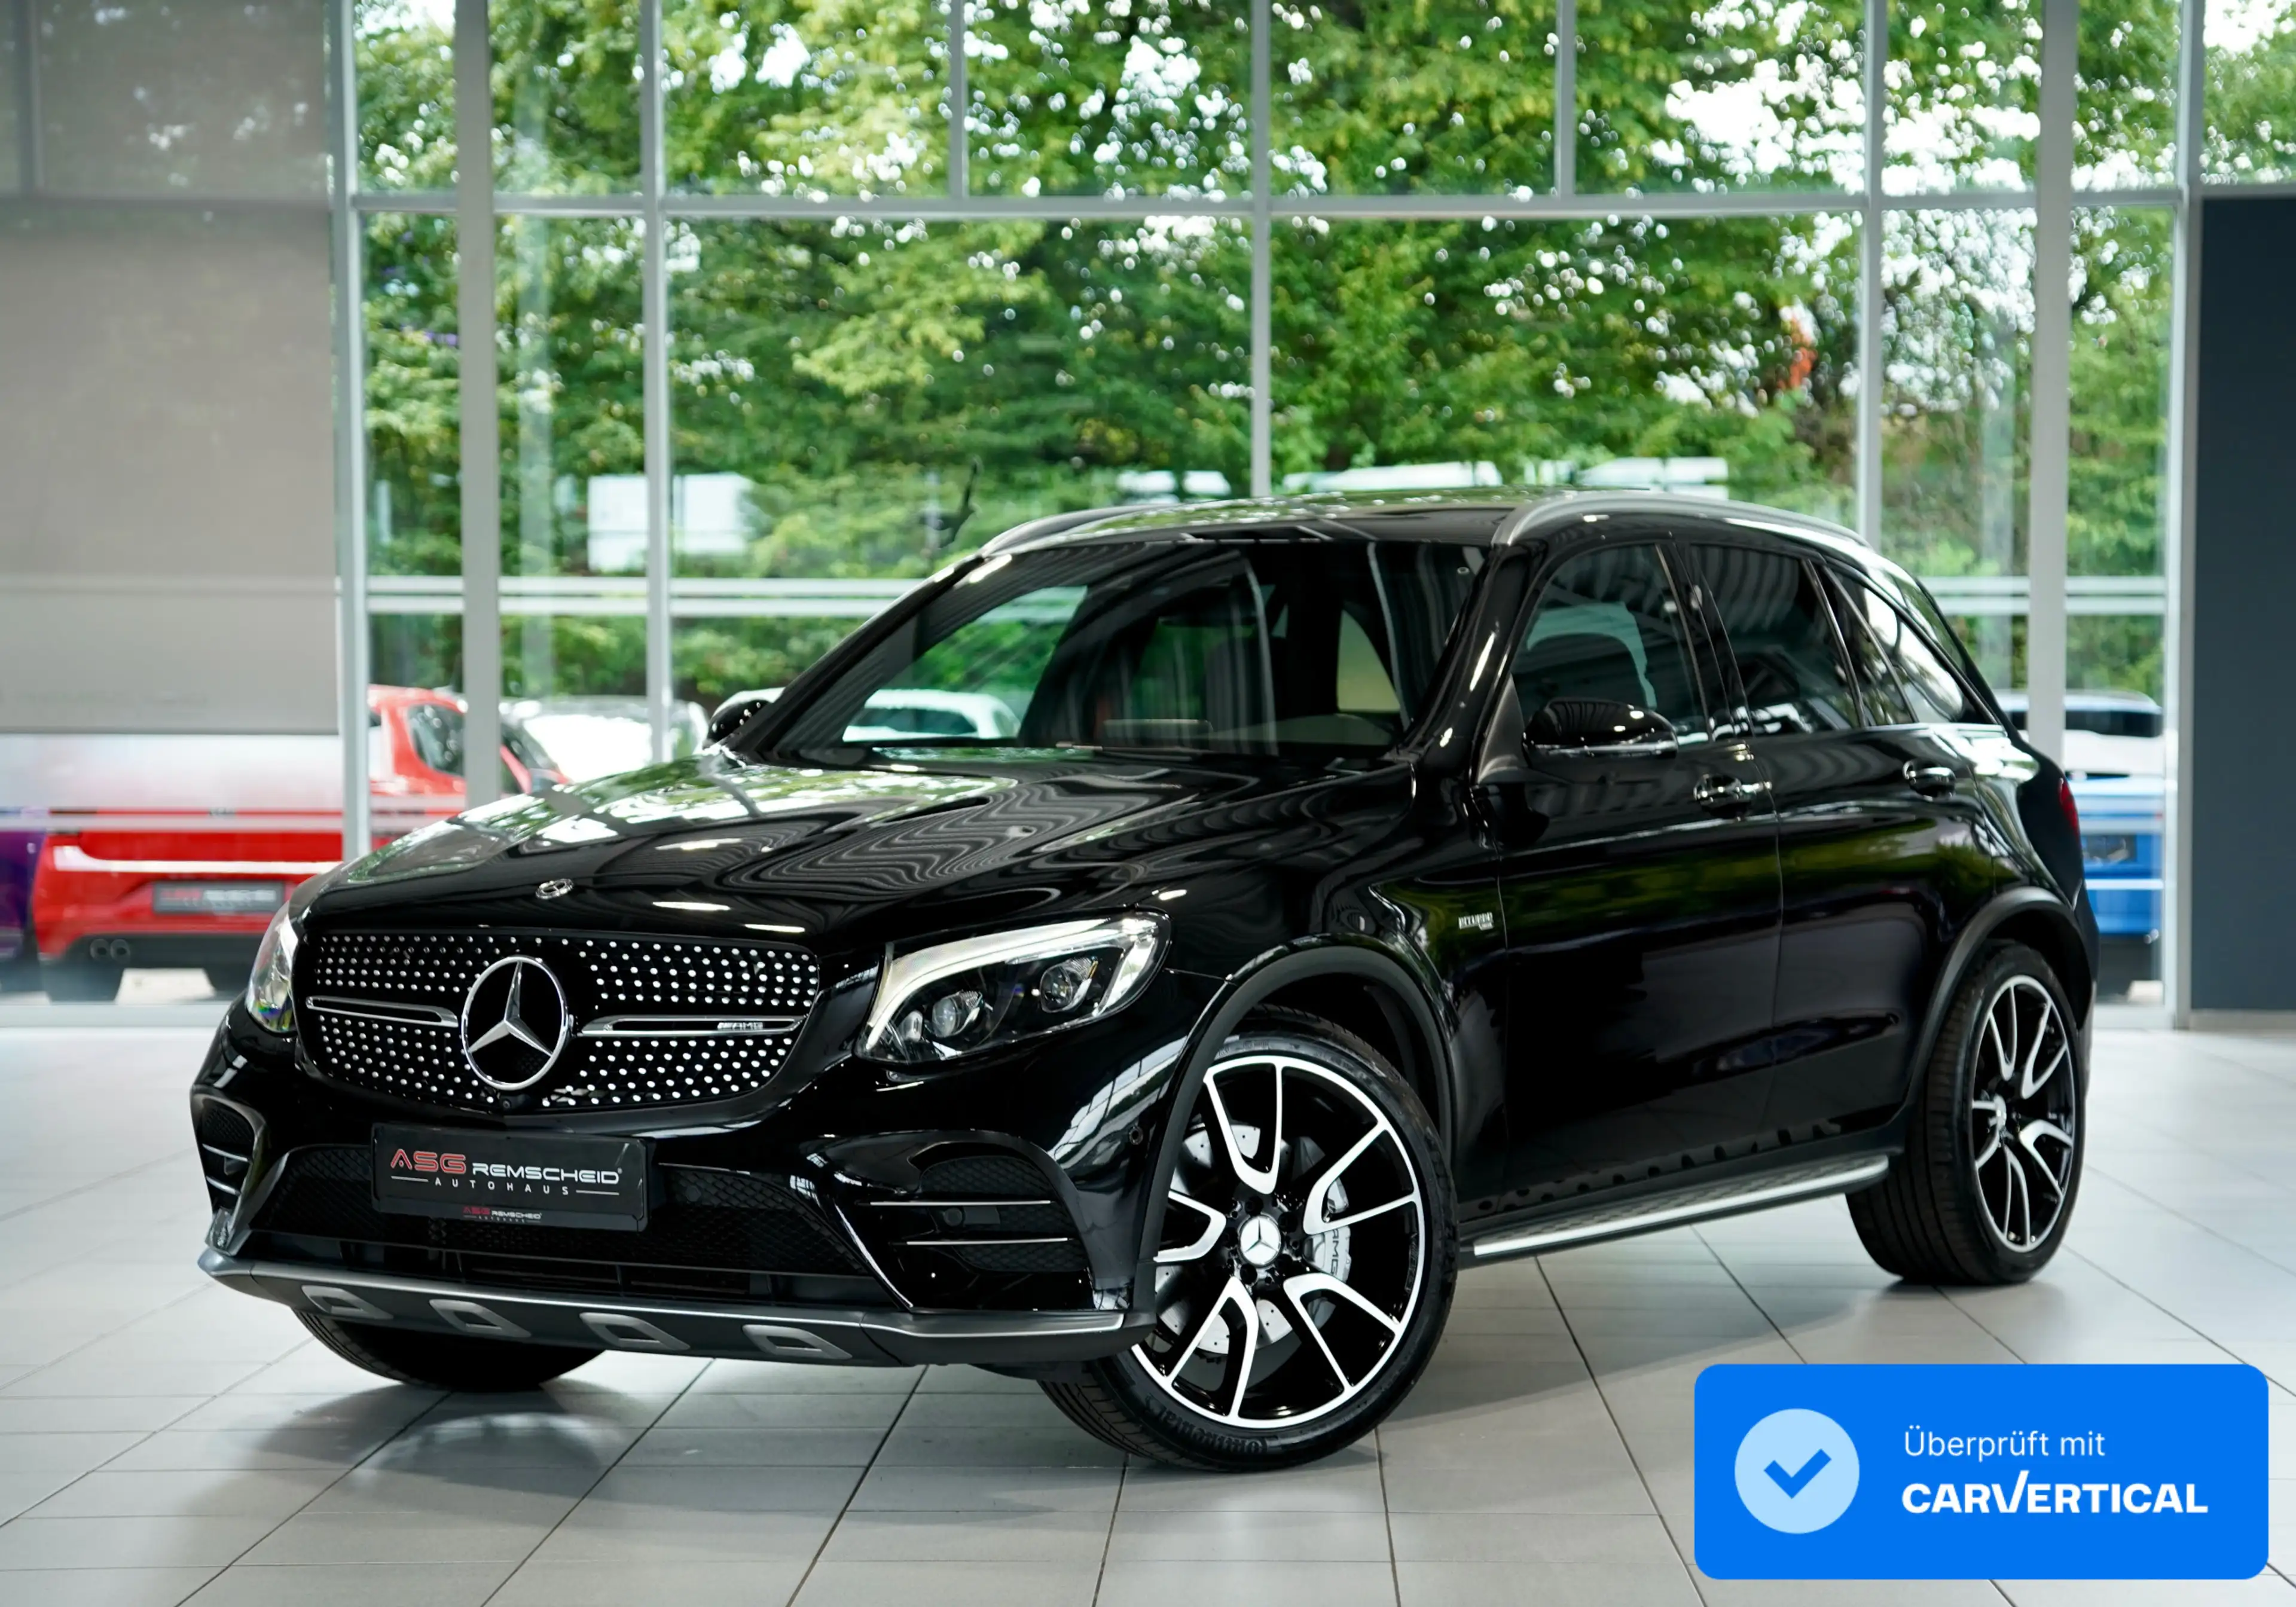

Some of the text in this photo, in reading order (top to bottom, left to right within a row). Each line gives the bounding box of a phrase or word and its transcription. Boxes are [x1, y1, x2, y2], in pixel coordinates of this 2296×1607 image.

[390, 1148, 619, 1185] ASG REMSCHEID
[435, 1178, 569, 1196] AUTOHAUS
